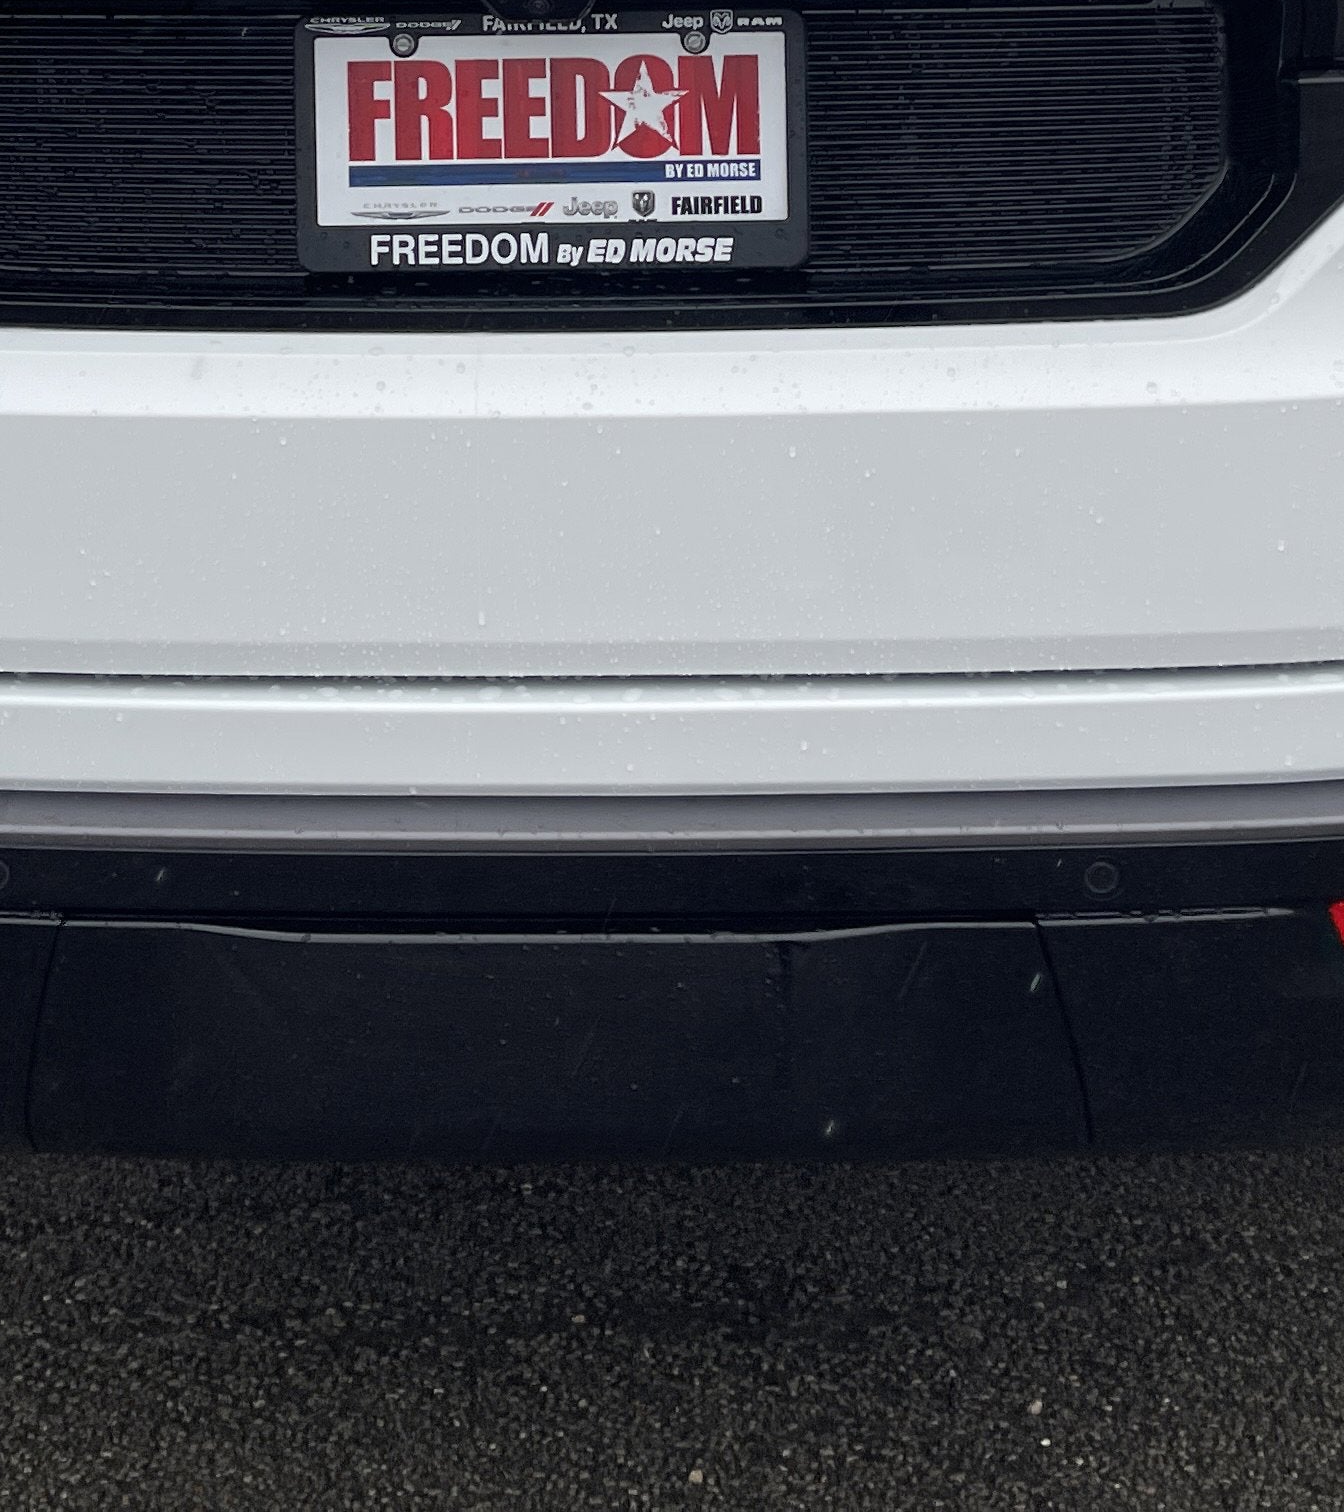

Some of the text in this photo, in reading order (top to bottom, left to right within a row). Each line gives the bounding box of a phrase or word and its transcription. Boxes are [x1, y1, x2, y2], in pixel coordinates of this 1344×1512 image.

[309, 16, 385, 24] CHRYSLER
[591, 13, 618, 30] TX
[662, 13, 704, 29] Jeep
[737, 16, 783, 26] RAM
[347, 53, 761, 161] FREEDOM
[665, 162, 756, 179] BY ED MORSE
[458, 205, 534, 214] DODGE
[562, 196, 619, 219] Jeep
[671, 195, 763, 216] FAIRFIELD
[370, 232, 735, 267] FREEDOM By ED MORSE
